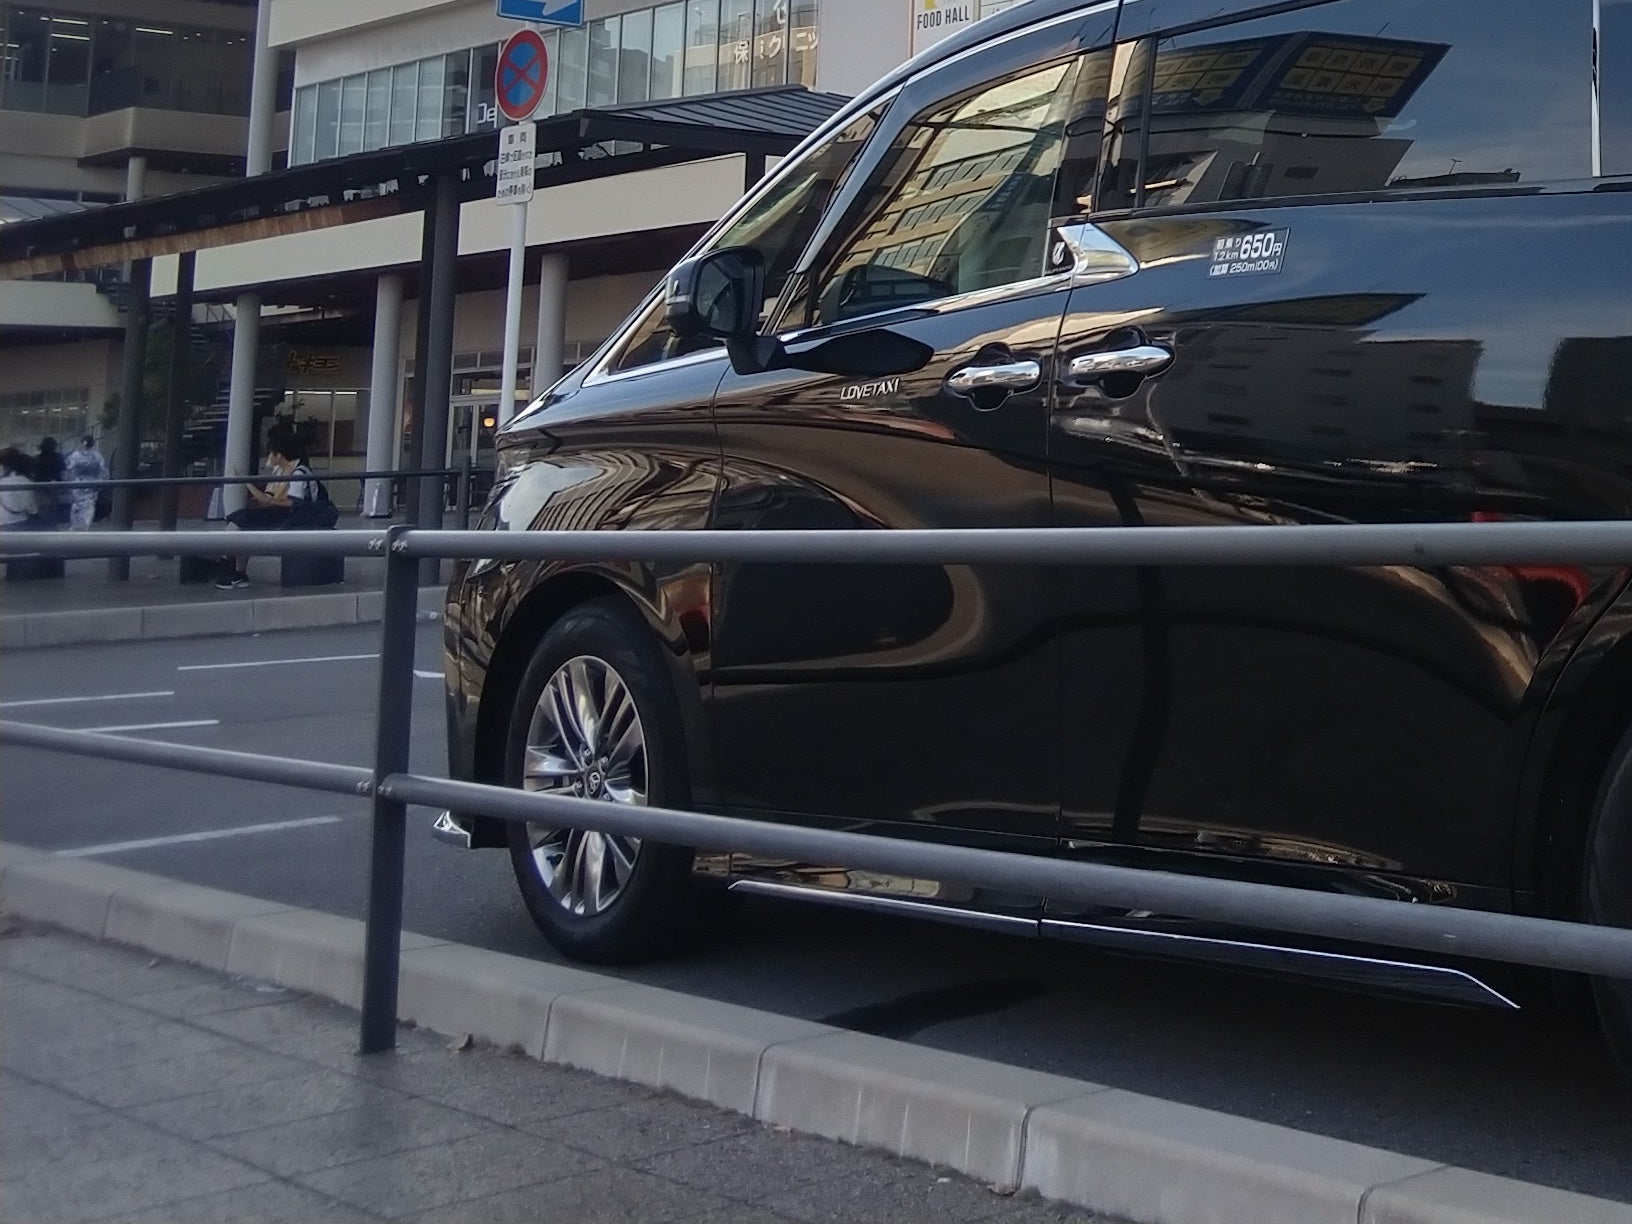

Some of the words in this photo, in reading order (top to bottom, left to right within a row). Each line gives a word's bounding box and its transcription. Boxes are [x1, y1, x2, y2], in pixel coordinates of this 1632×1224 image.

[917, 10, 941, 30] FOOD
[945, 5, 970, 25] HALL
[840, 377, 900, 399] LOVETAXI
